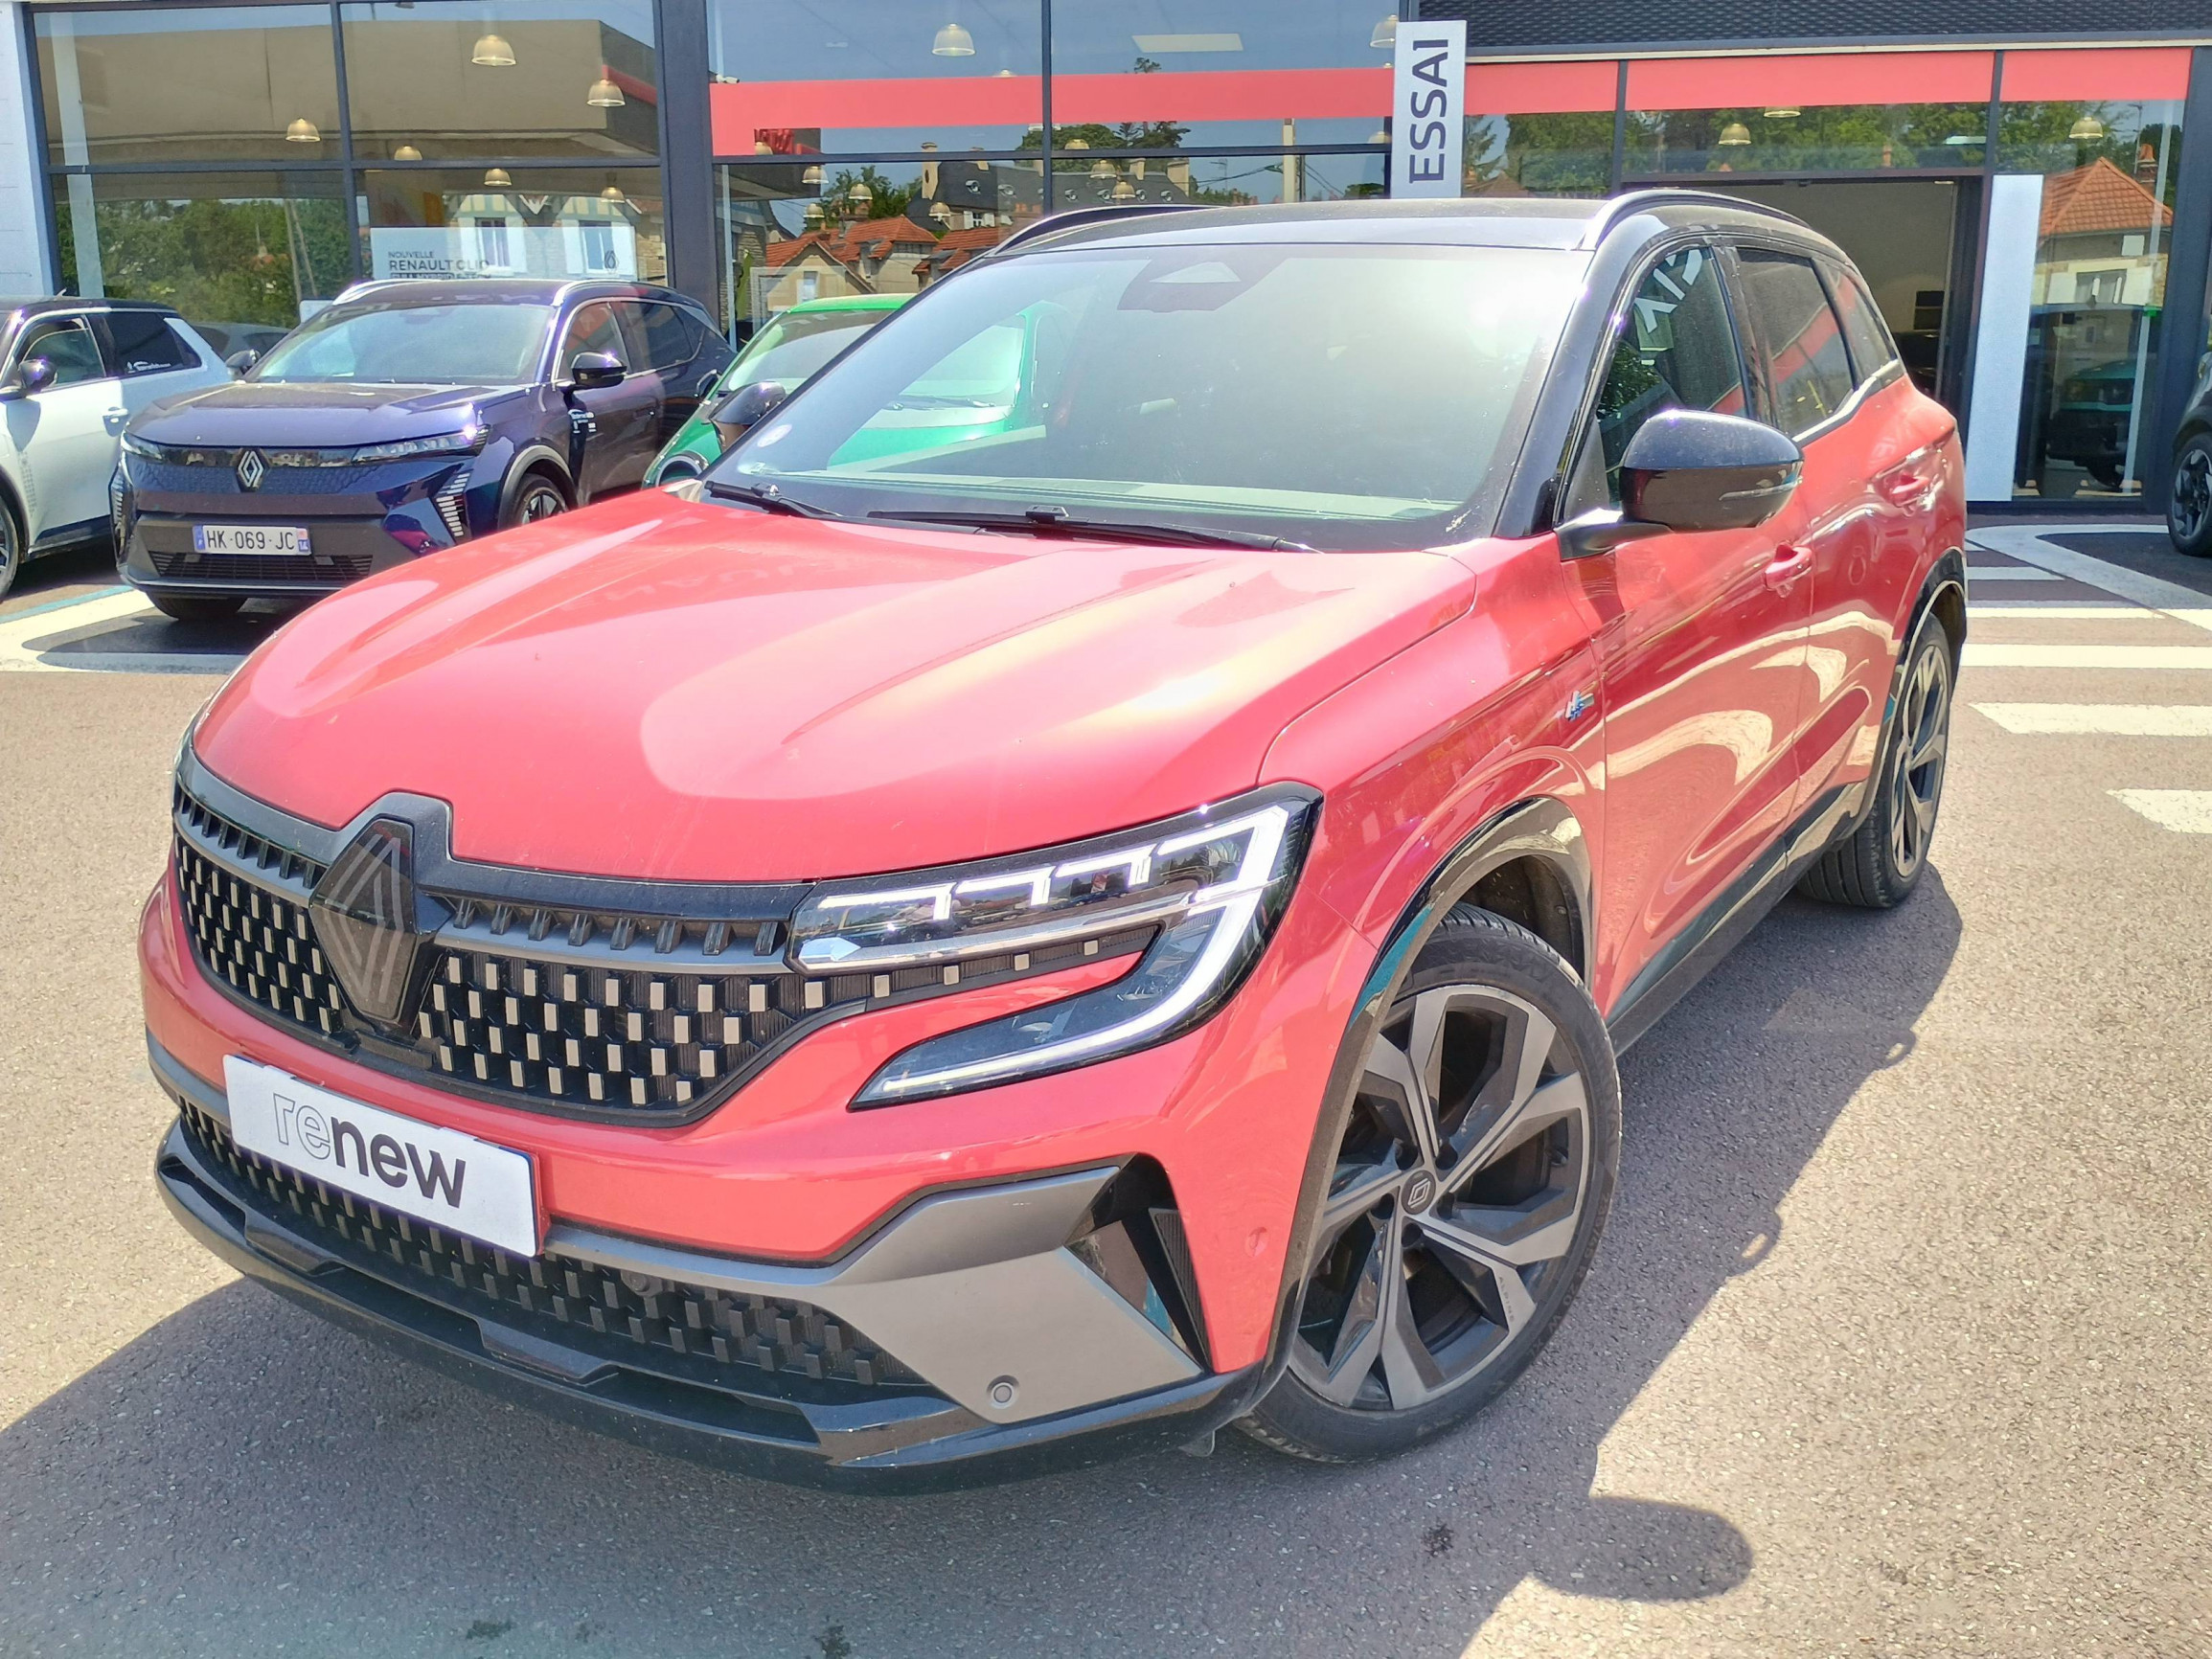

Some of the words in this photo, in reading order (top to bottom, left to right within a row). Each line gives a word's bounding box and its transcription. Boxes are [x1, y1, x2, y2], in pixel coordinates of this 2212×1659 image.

[1409, 39, 1448, 184] ESSAI
[389, 260, 453, 271] RENAULT
[273, 1093, 467, 1209] renew
